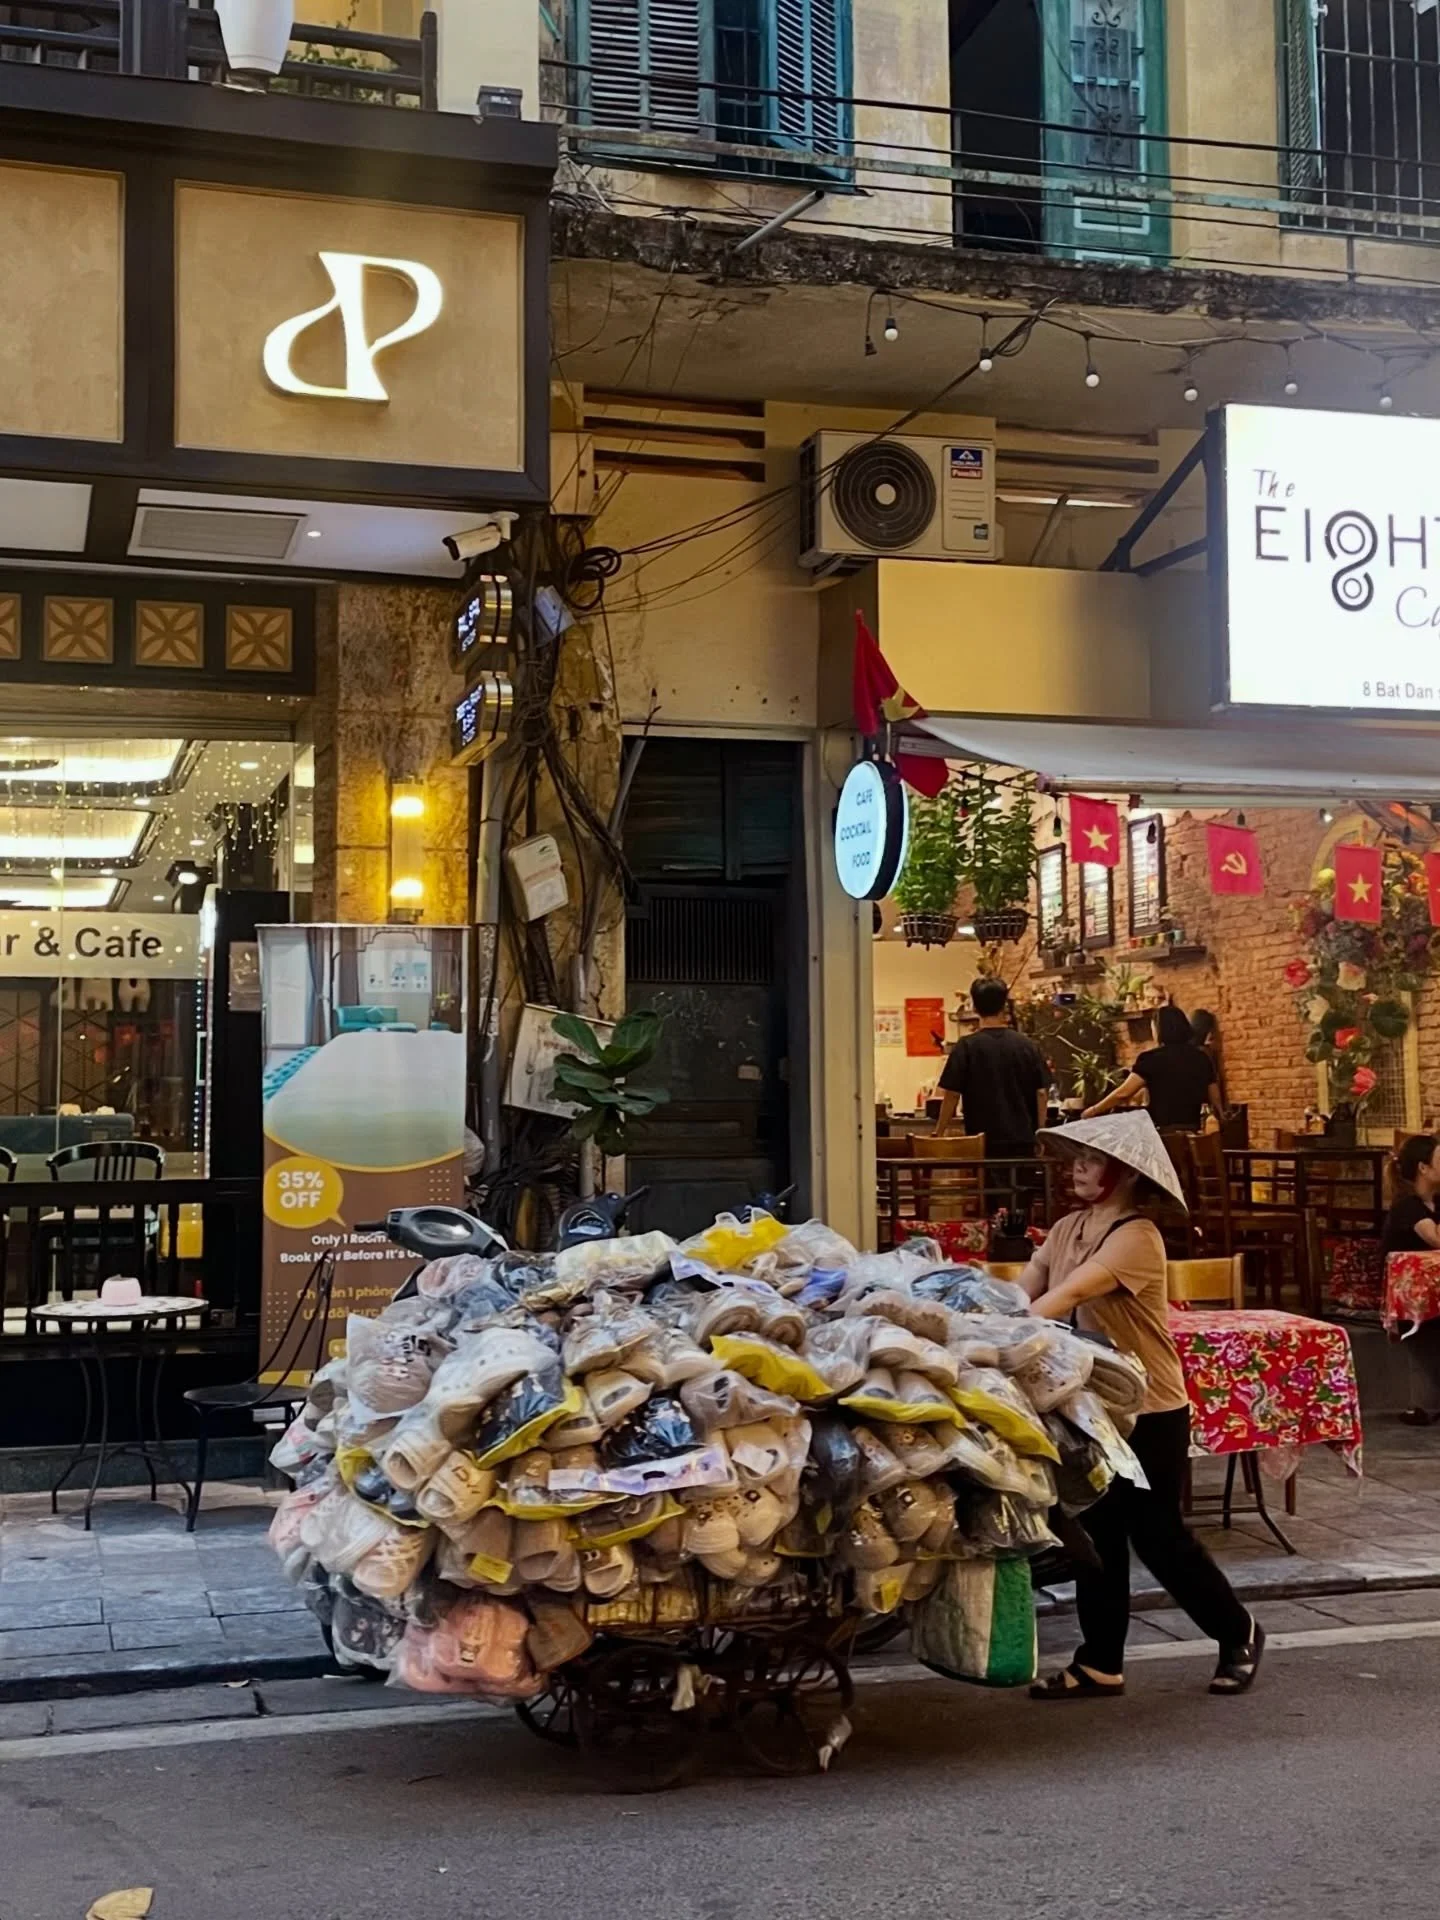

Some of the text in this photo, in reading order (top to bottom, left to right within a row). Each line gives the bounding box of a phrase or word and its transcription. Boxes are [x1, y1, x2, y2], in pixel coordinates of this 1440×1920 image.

[1252, 468, 1296, 498] The
[1255, 505, 1440, 612] EIGH
[1363, 680, 1433, 699] 8 Bat Dan
[857, 789, 872, 806] CAFE
[841, 821, 871, 840] COCKTAIL
[853, 852, 870, 868] FOOD
[34, 926, 61, 957] &
[75, 927, 162, 958] Cafe
[278, 1171, 324, 1189] 35%
[280, 1191, 321, 1209] OFF
[311, 1233, 386, 1248] Only 1 Room
[280, 1252, 311, 1263] Book
[343, 1250, 383, 1261] Before
[385, 1249, 405, 1260] It's
